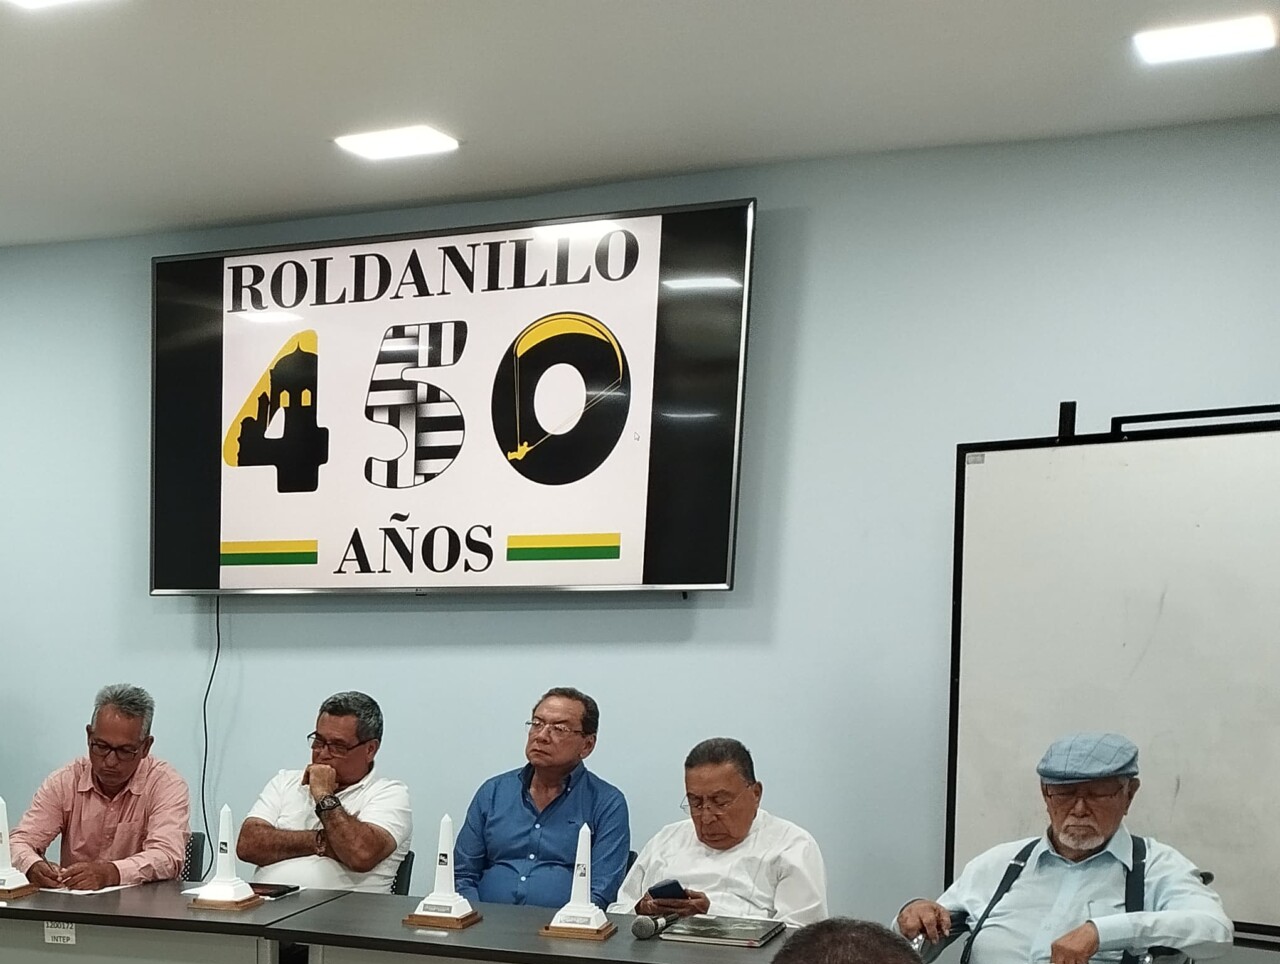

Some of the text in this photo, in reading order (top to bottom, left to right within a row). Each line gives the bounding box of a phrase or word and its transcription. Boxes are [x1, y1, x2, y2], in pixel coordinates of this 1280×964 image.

[227, 229, 640, 313] ROLDANILLO
[223, 311, 632, 493] 450
[333, 513, 494, 574] AÑOS
[51, 935, 71, 943] INTEP
